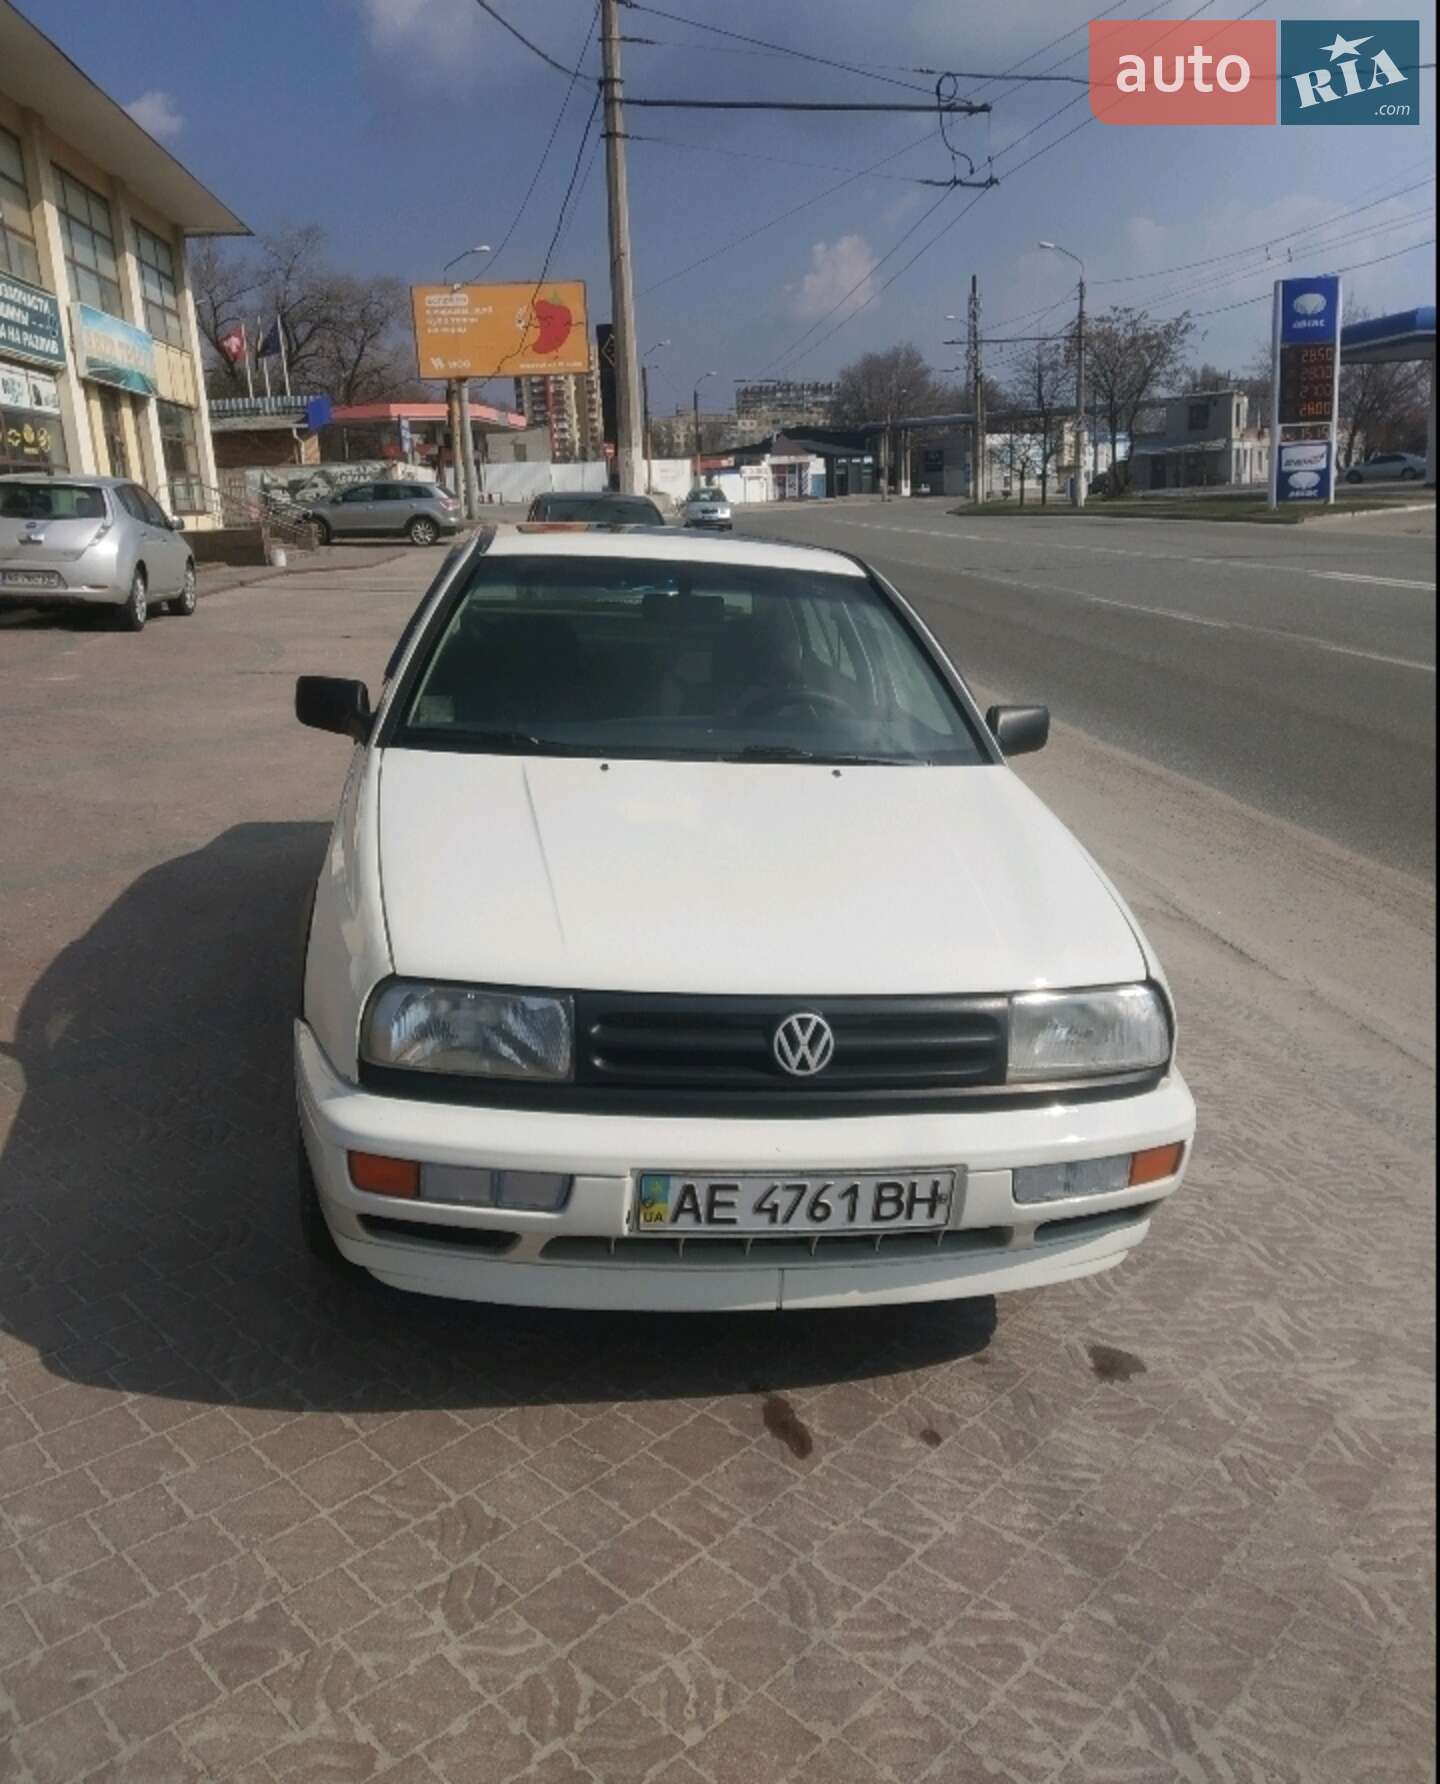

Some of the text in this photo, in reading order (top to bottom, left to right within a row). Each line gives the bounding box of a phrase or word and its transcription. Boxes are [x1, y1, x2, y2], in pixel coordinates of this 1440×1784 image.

[671, 1179, 941, 1225] AE 4761 BH
